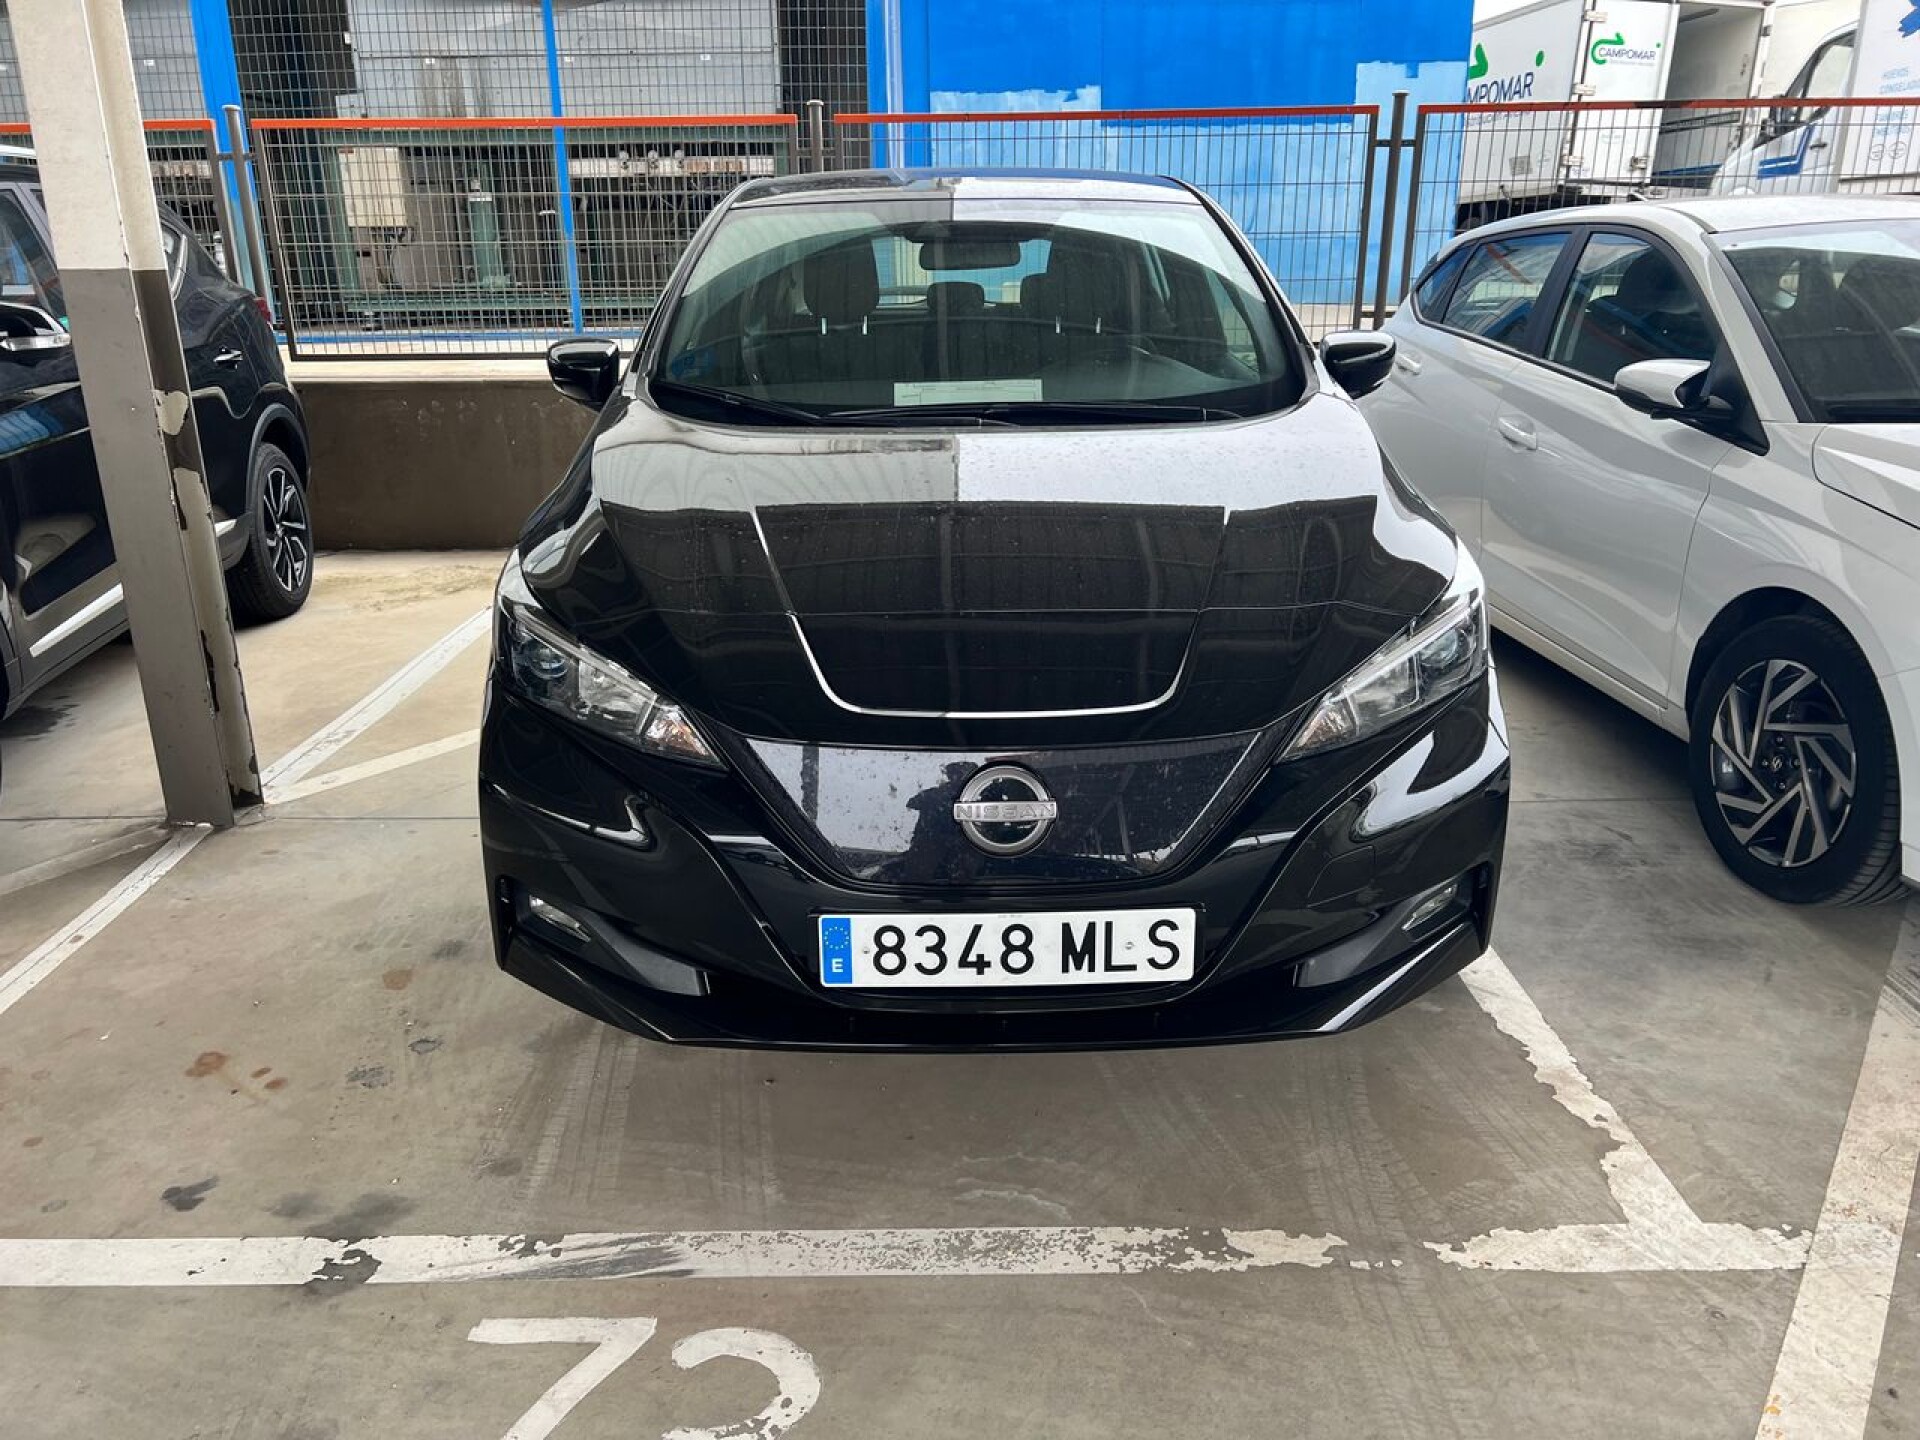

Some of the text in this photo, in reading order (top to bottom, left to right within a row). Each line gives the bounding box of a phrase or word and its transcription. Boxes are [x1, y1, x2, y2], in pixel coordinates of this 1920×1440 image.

[1598, 47, 1656, 60] CAMPOMAR
[1467, 72, 1534, 103] MPOMAR
[955, 802, 1055, 819] NISSAN
[872, 919, 1181, 976] 8348 MLS
[831, 958, 844, 973] E
